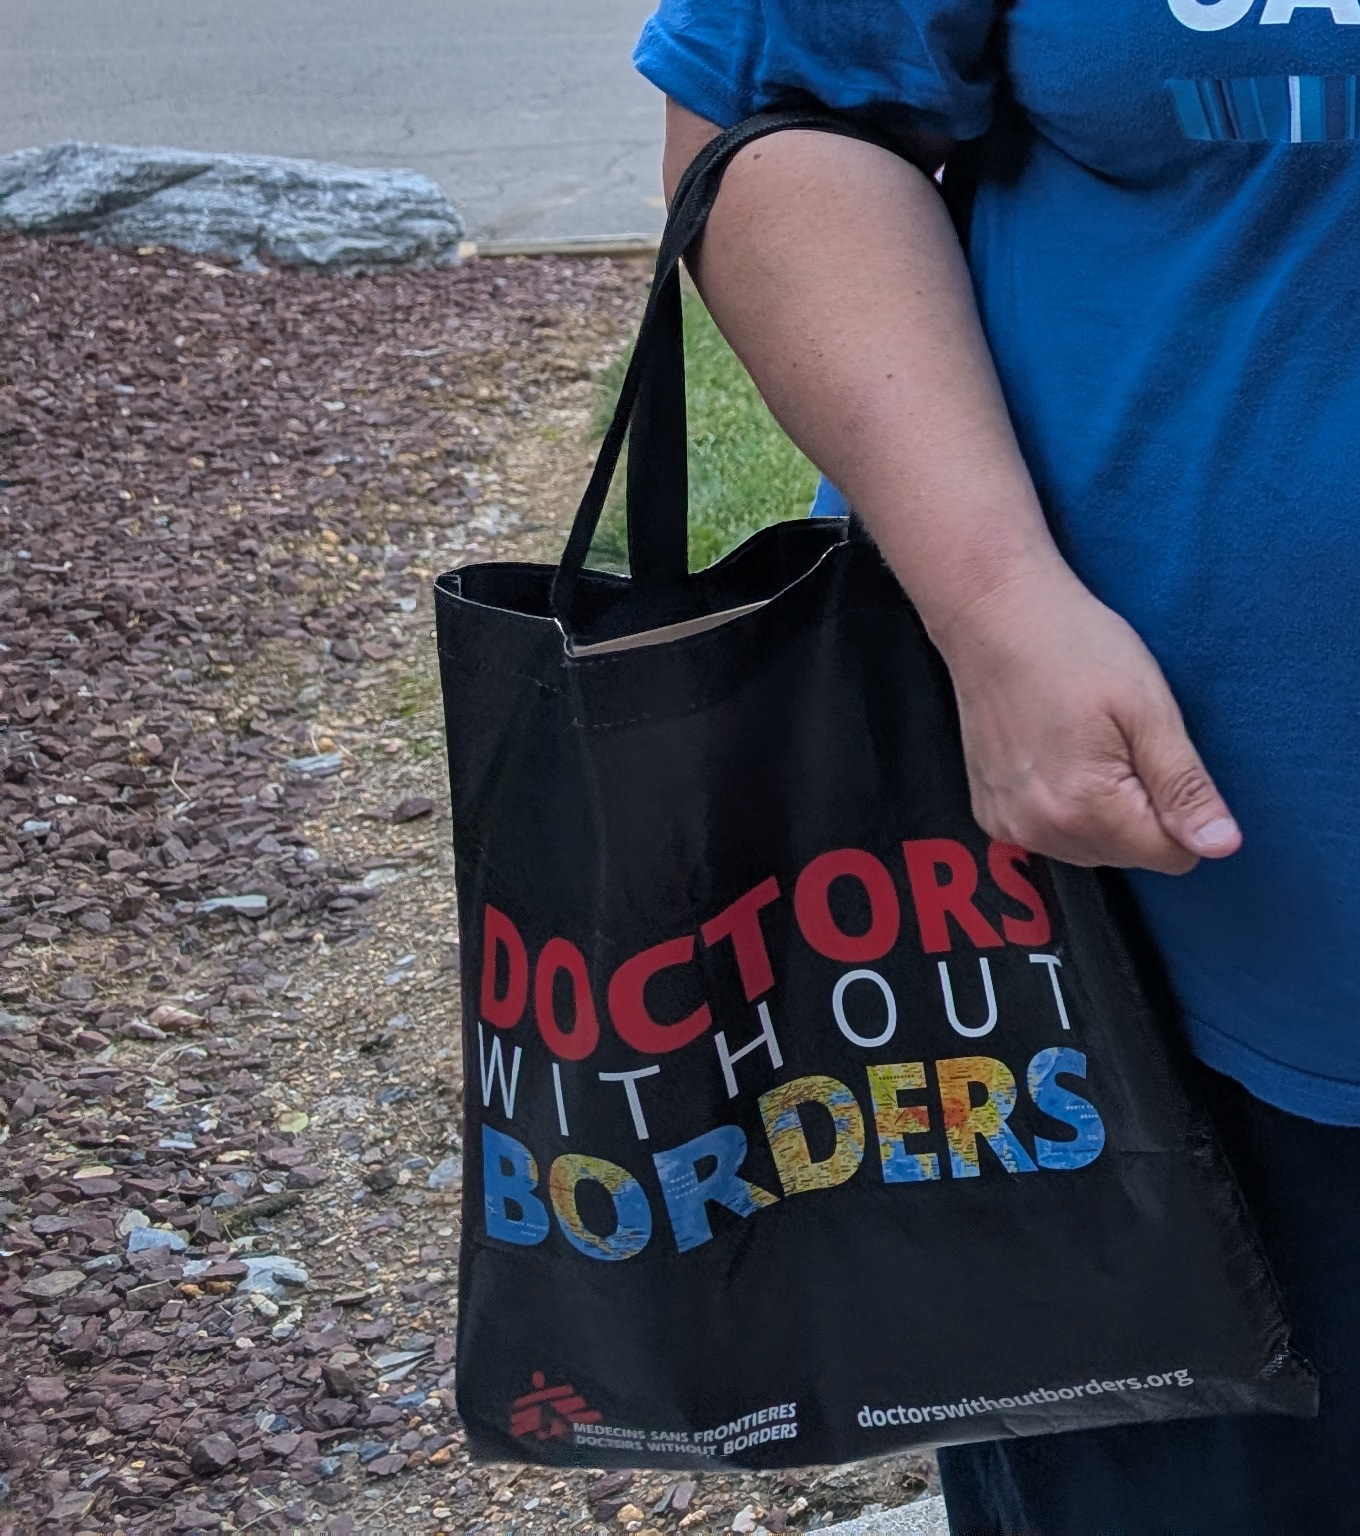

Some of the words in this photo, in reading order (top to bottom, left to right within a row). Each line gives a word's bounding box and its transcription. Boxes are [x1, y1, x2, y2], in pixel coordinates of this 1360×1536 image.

[479, 837, 1052, 1061] DOCTORS
[477, 951, 1071, 1140] WITHOUT
[481, 1046, 1106, 1261] BORDERS
[573, 1421, 646, 1441] MEDECINS
[650, 1430, 689, 1443] SANS
[694, 1402, 797, 1444] FRONTIERES
[647, 1440, 717, 1457] WITHOUT
[723, 1422, 798, 1456] BORDERS
[857, 1368, 1194, 1428] doctorswithoutborders.org
